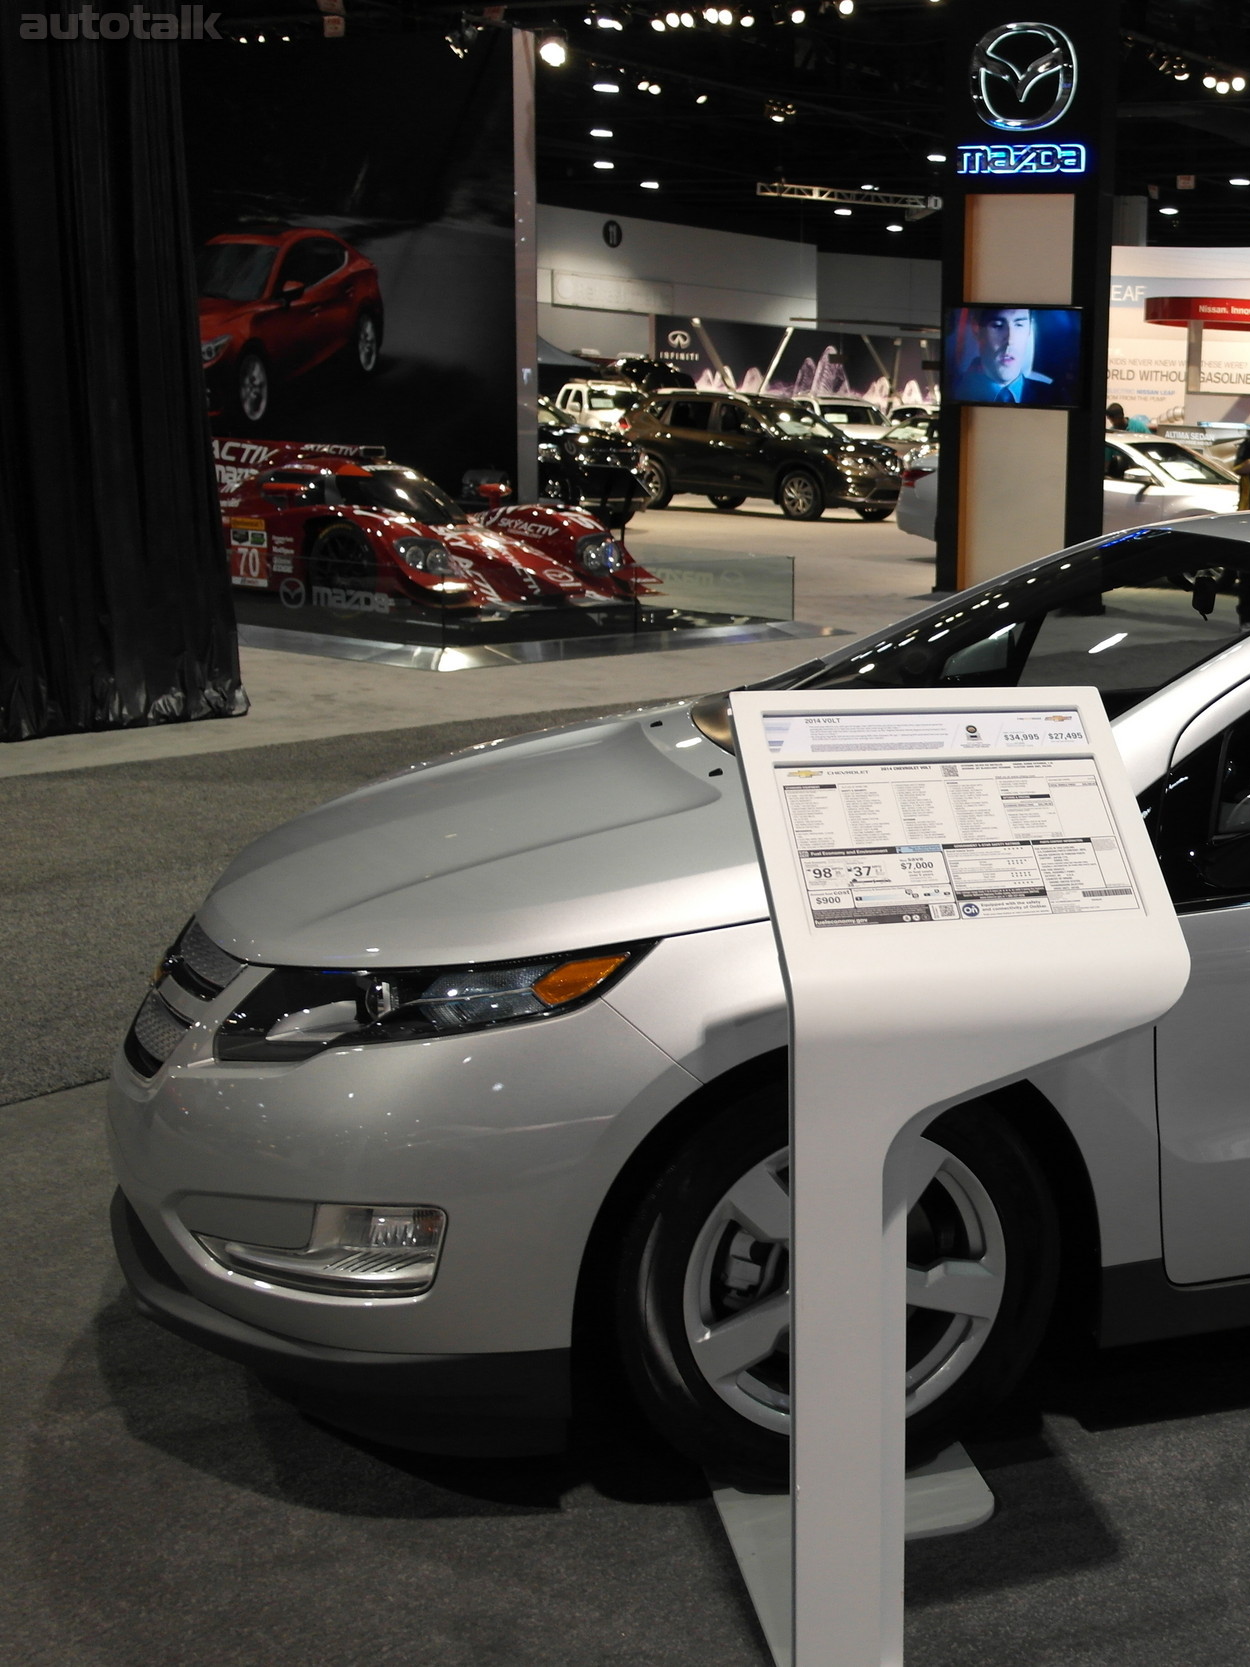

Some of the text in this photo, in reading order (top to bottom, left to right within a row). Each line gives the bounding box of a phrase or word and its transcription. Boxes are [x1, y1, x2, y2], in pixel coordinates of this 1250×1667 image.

[957, 143, 1086, 174] mazda
[1111, 285, 1147, 301] EAF
[660, 351, 700, 361] INFINITI
[1138, 370, 1186, 383] WITHOU
[1164, 431, 1216, 442] ALTIMA SEDAN
[301, 444, 359, 456] SKYACTIV
[498, 517, 560, 536] SKYACTIV
[236, 547, 260, 578] 70
[311, 585, 391, 614] mazda
[1003, 732, 1083, 741] $34,995 $27,495
[812, 866, 872, 879] 98 37
[900, 862, 934, 870] $7,000
[815, 896, 841, 905] $900
